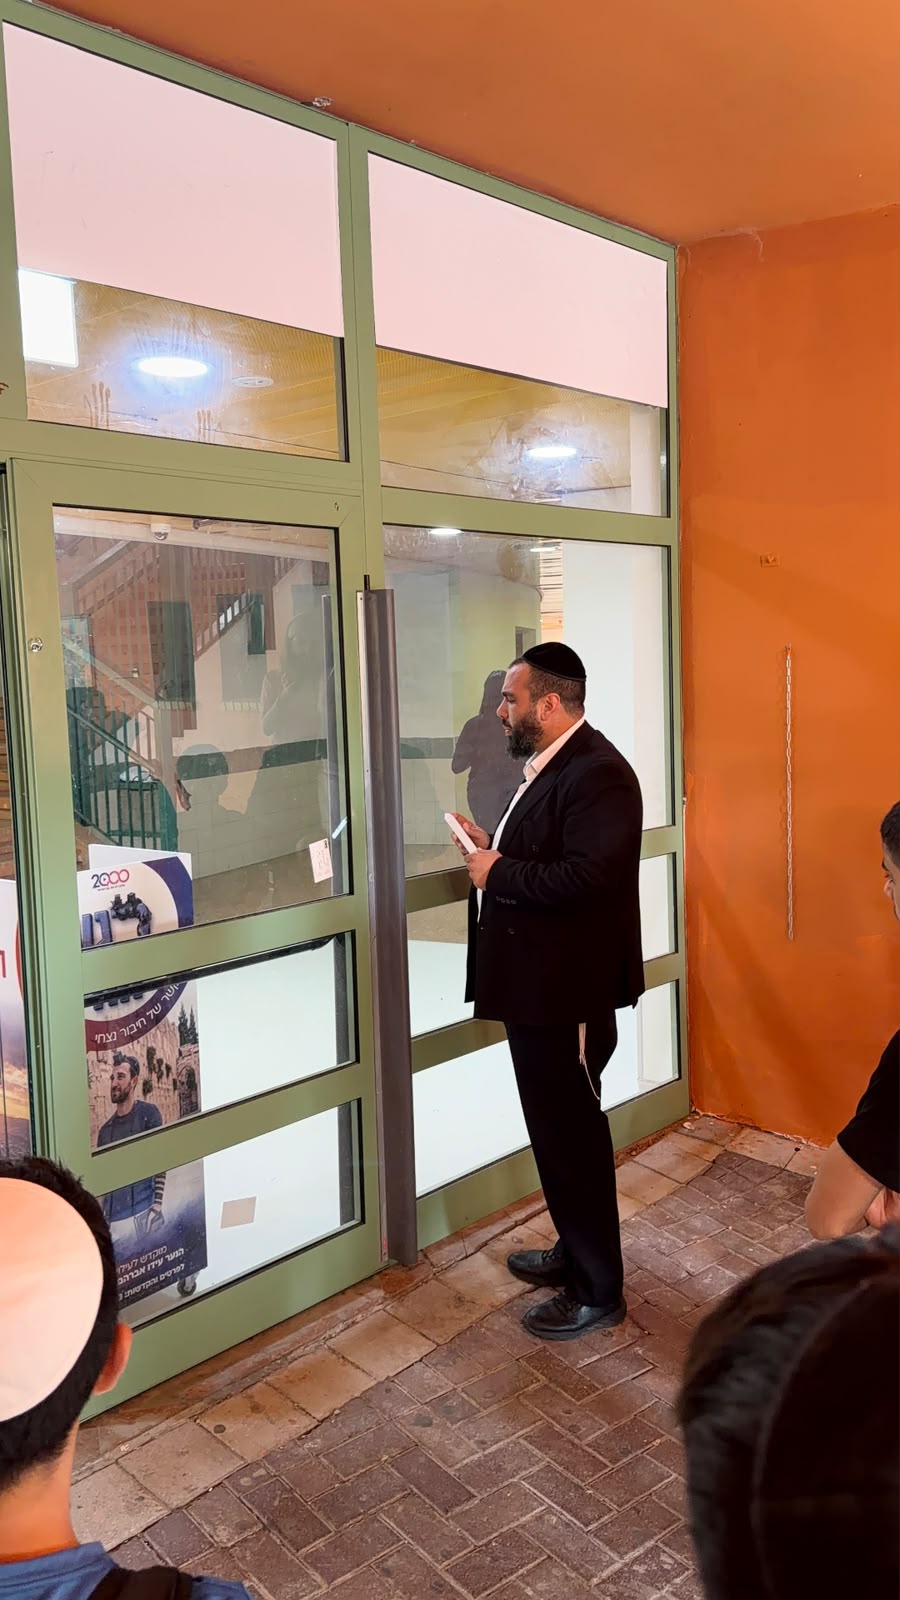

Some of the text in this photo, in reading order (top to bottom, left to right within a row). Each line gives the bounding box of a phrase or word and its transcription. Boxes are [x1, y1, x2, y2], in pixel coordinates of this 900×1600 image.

[146, 1003, 162, 1020] של
[120, 1017, 147, 1037] חיבור
[95, 1031, 117, 1044] נצחי
[140, 1245, 168, 1264] מוקדש
[117, 1247, 185, 1285] הנער עידו אברהם
[160, 1263, 185, 1282] לפרטים
